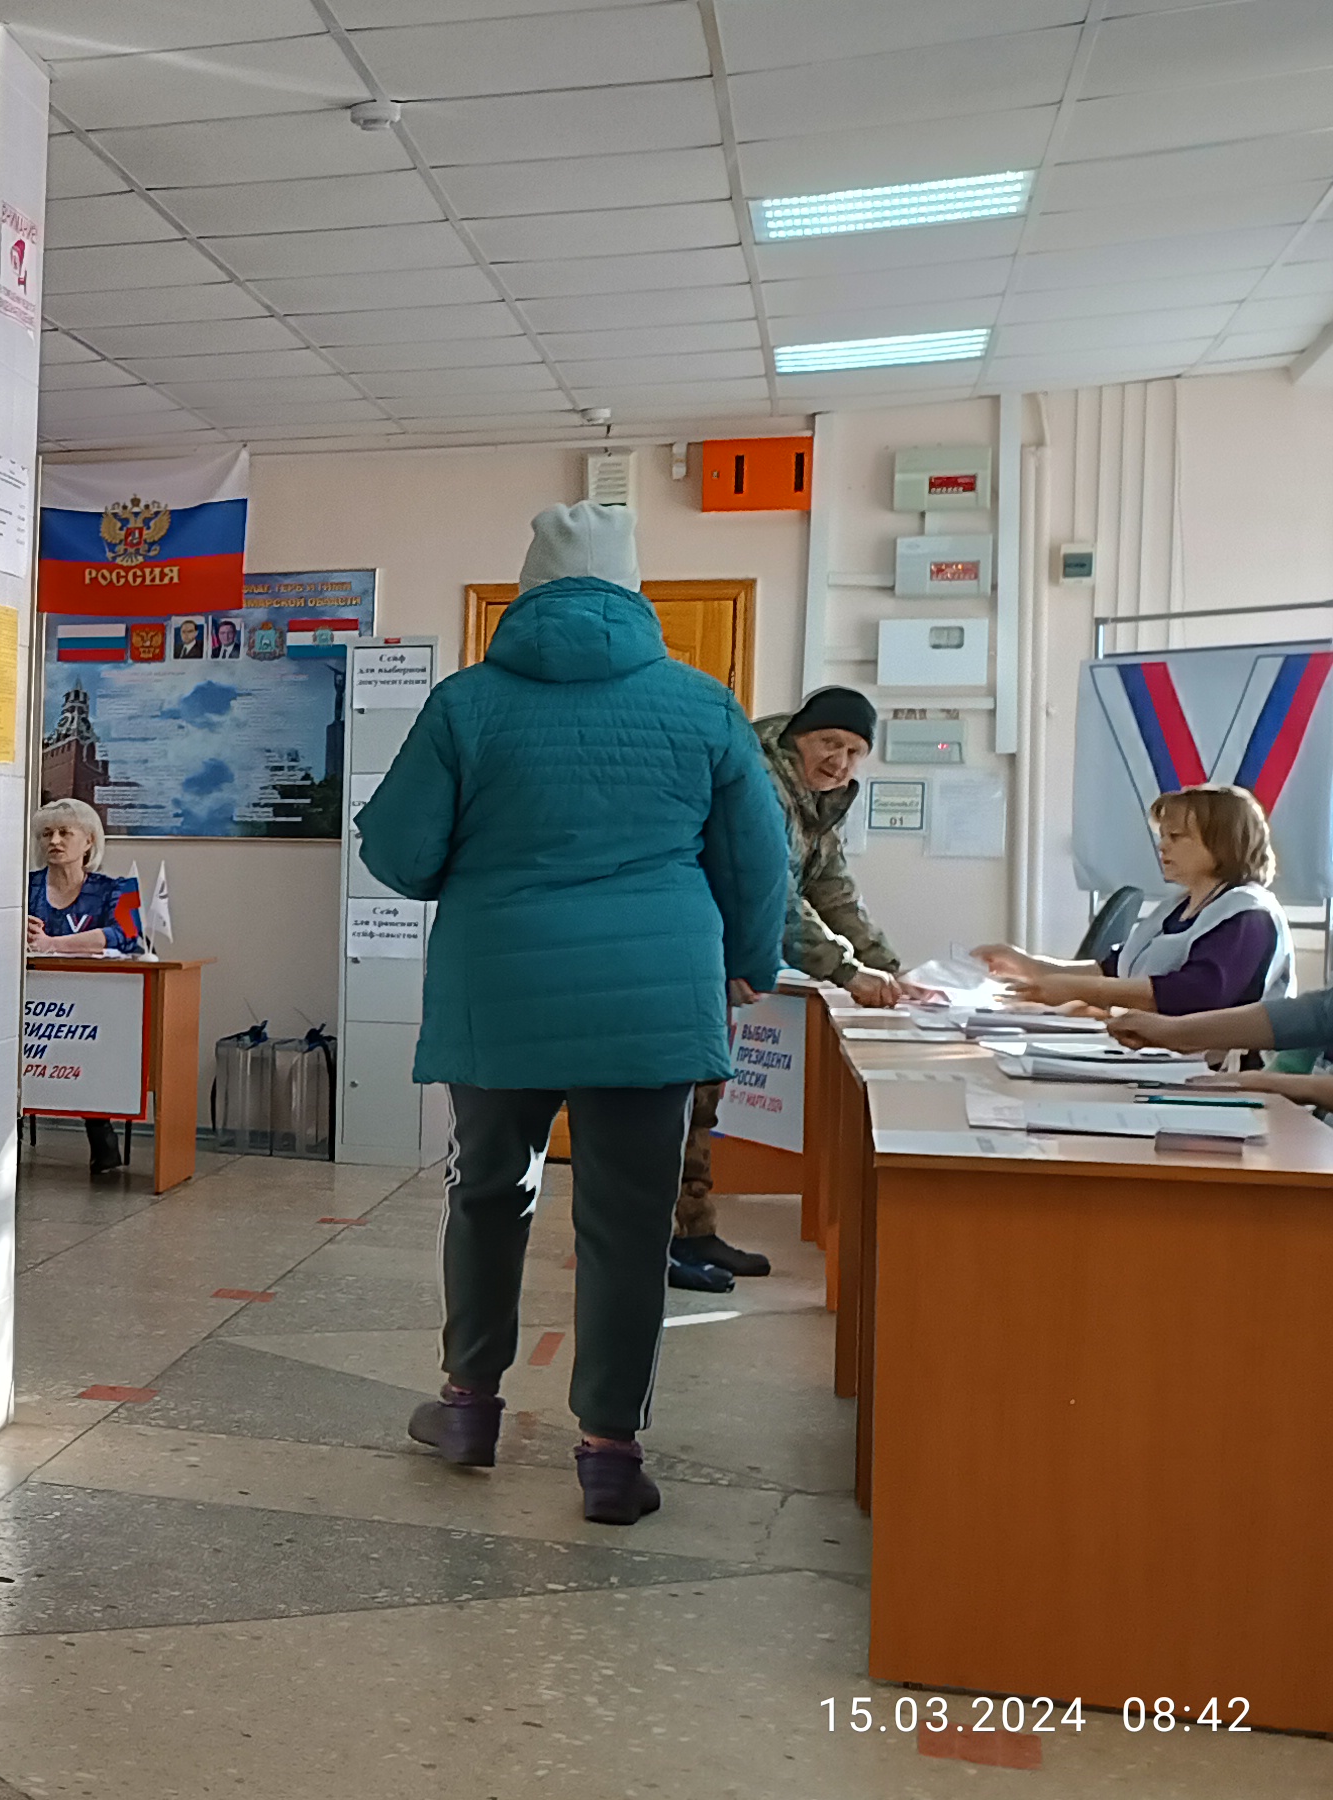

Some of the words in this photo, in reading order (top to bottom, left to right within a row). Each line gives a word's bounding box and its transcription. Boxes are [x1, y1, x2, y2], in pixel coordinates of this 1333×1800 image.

[84, 566, 180, 587] РОССИЯ
[741, 1023, 781, 1045] ВЫБОРЫ
[736, 1046, 792, 1071] ПРЕЗИДЕНТА
[48, 1065, 81, 1080] 2024
